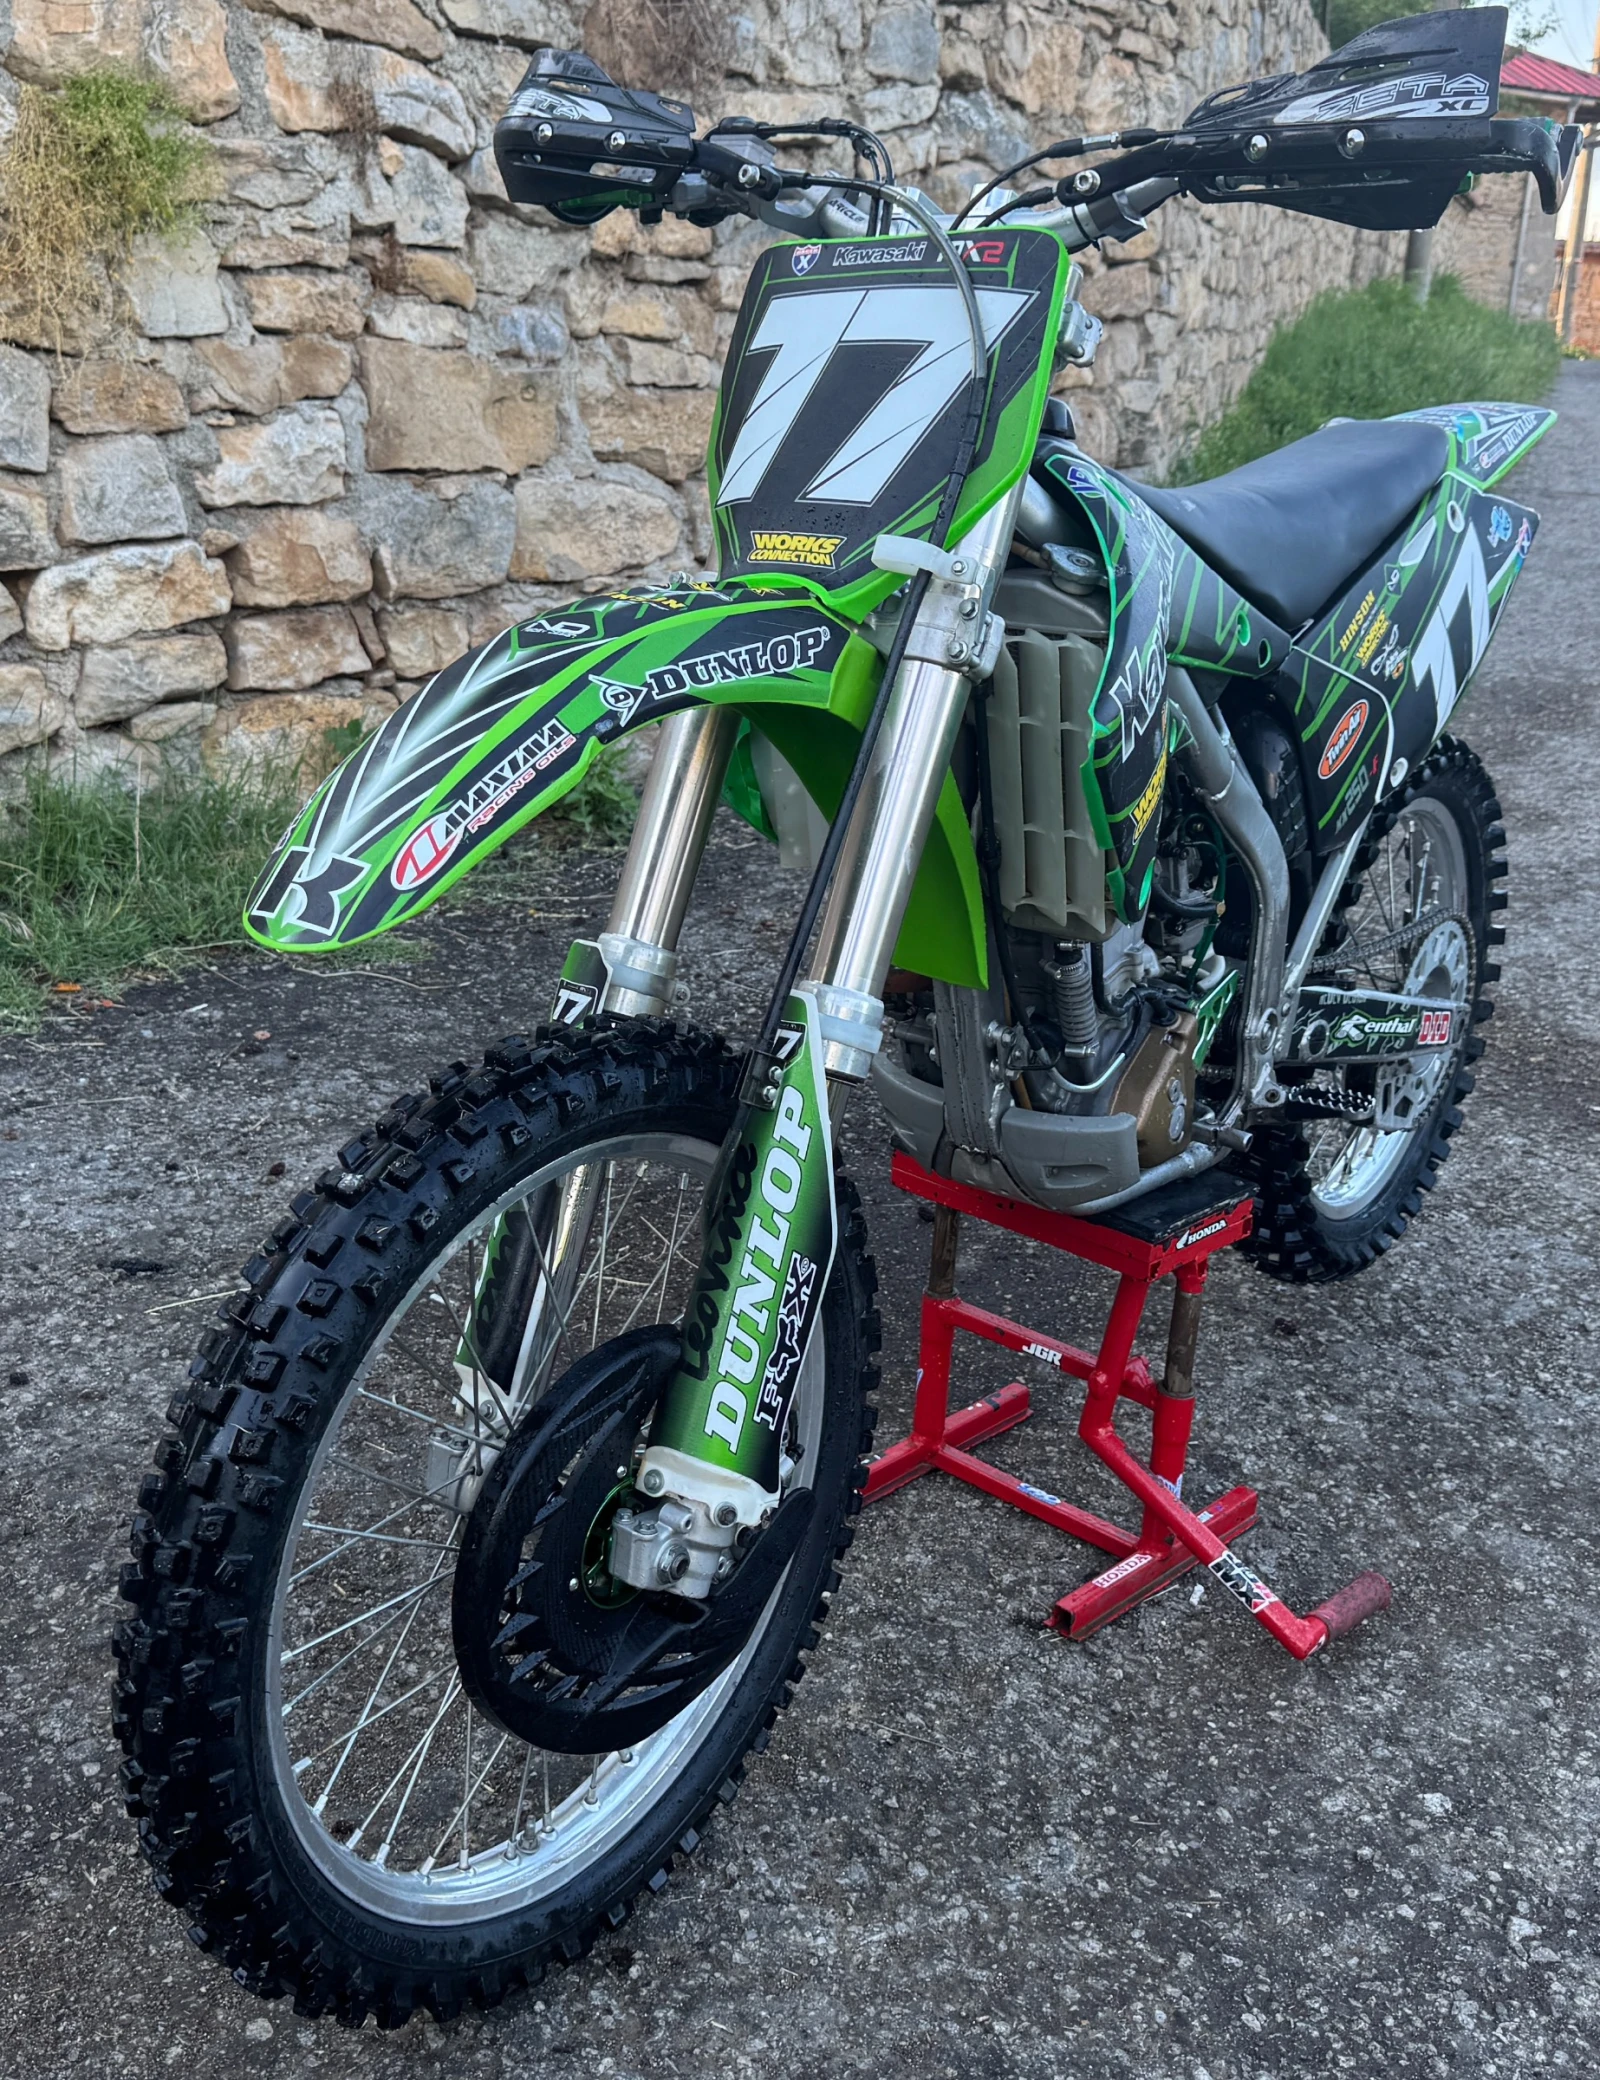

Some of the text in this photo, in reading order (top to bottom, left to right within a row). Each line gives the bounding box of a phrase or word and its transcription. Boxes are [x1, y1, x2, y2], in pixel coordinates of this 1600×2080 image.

[1316, 73, 1490, 122] ZETA
[1437, 99, 1485, 113] XC
[832, 241, 928, 267] Kawasaki
[715, 284, 1041, 507] 17
[749, 547, 833, 566] CONNECTION
[753, 532, 842, 554] WORKS
[1339, 590, 1376, 652] HINSON
[1355, 609, 1386, 660] WORKS
[647, 627, 825, 700] DUNLOP
[1325, 729, 1349, 767] Twin
[444, 717, 573, 840] MAXIMA
[466, 734, 577, 834] RACING OILS
[551, 987, 592, 1025] 17
[1336, 1011, 1451, 1045] Renthal DID
[1187, 1219, 1227, 1244] HONDA
[703, 1084, 813, 1456] DUNLOP
[1022, 1341, 1063, 1367] JGR
[1096, 1554, 1150, 1589] HONDA
